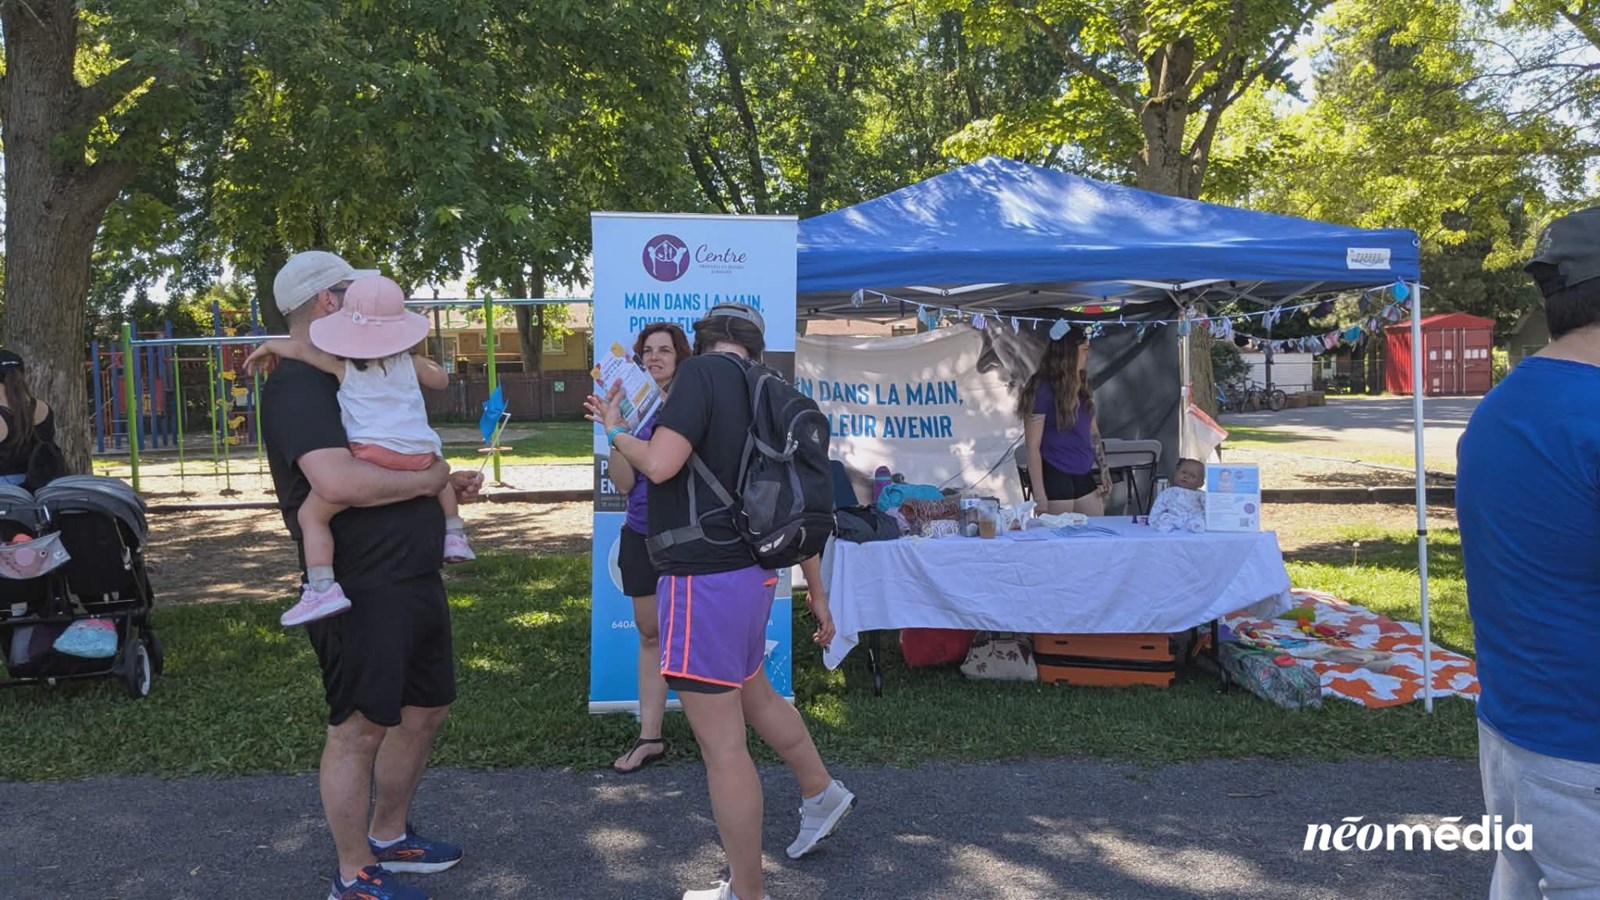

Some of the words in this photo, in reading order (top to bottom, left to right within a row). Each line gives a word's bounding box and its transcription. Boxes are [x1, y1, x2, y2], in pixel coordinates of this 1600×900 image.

[695, 244, 748, 263] Centre
[624, 292, 660, 309] MAIN
[664, 293, 701, 310] DANS
[819, 380, 870, 404] DANS
[875, 383, 901, 405] LA
[906, 380, 963, 406] MAIN,
[829, 413, 877, 438] LEUR
[882, 415, 953, 439] AVENIR
